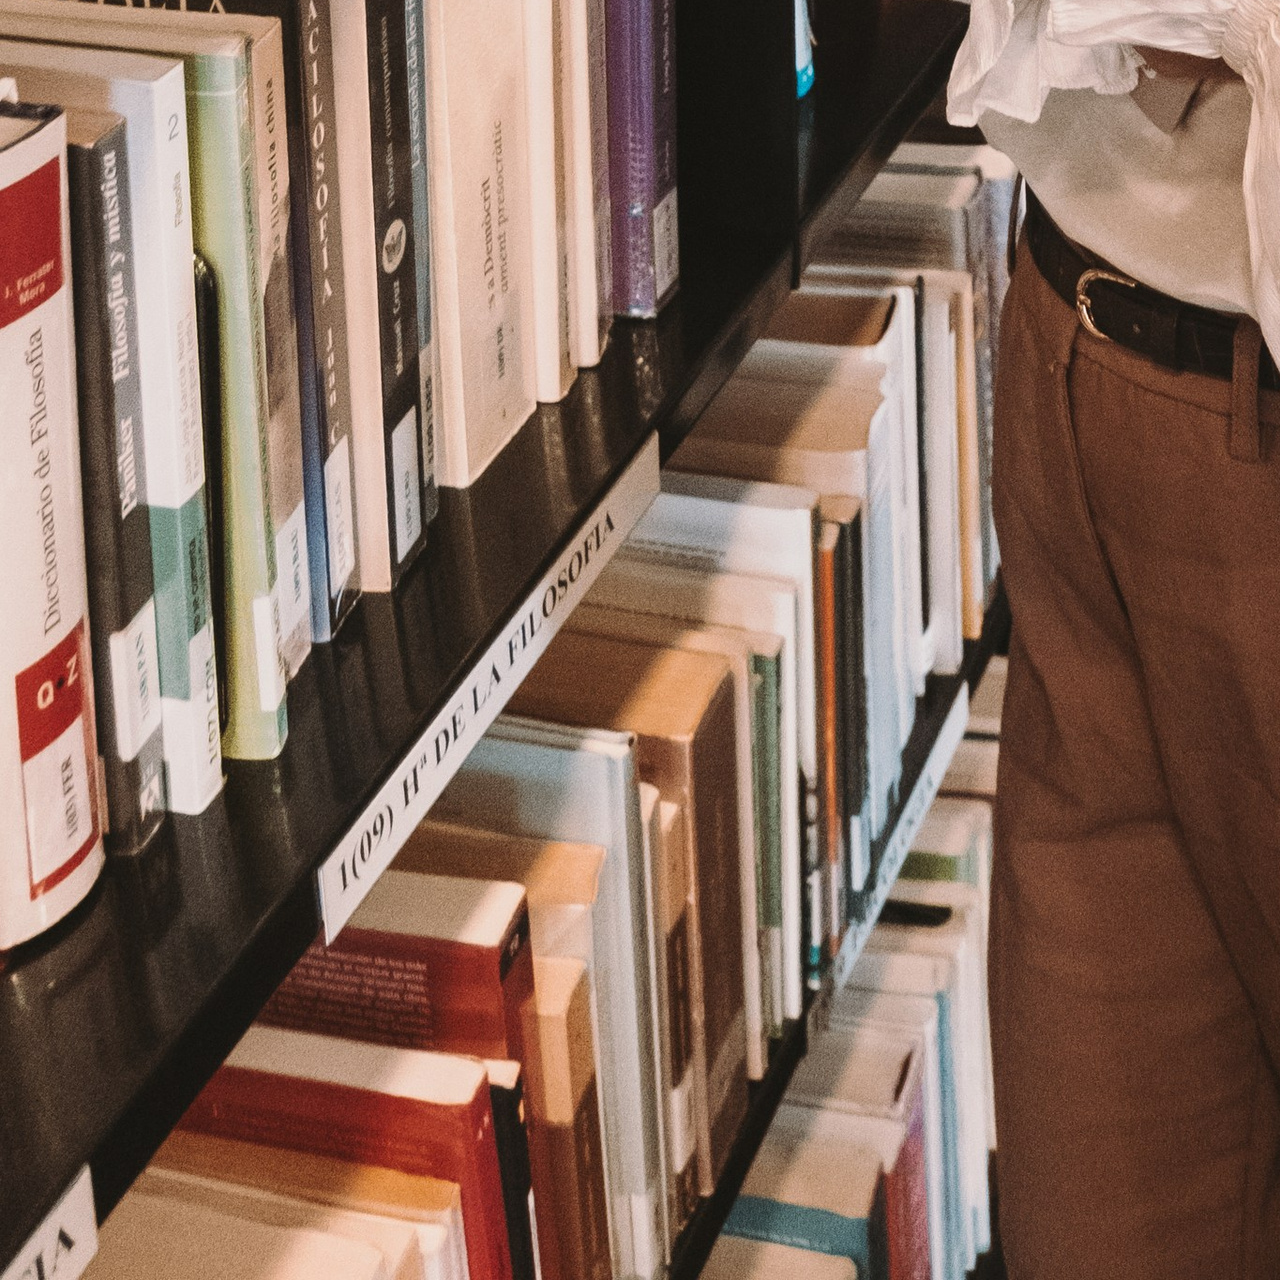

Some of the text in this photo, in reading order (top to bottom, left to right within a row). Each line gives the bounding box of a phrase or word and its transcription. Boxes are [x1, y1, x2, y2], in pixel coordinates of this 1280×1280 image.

[406, 15, 418, 49] los
[407, 51, 419, 71] de
[264, 77, 276, 133] china
[408, 73, 421, 141] escuela
[411, 144, 422, 170] La
[16, 259, 56, 291] Ferrater
[18, 281, 47, 307] Mora
[101, 149, 137, 520] Pániker Filosofía y mística
[27, 324, 62, 637] Diccionario de Filosofía
[337, 801, 396, 893] 1(09)
[433, 702, 468, 766] DE
[472, 661, 502, 715] LA
[507, 510, 616, 669] FILOSOFIA
[60, 753, 75, 797] FER
